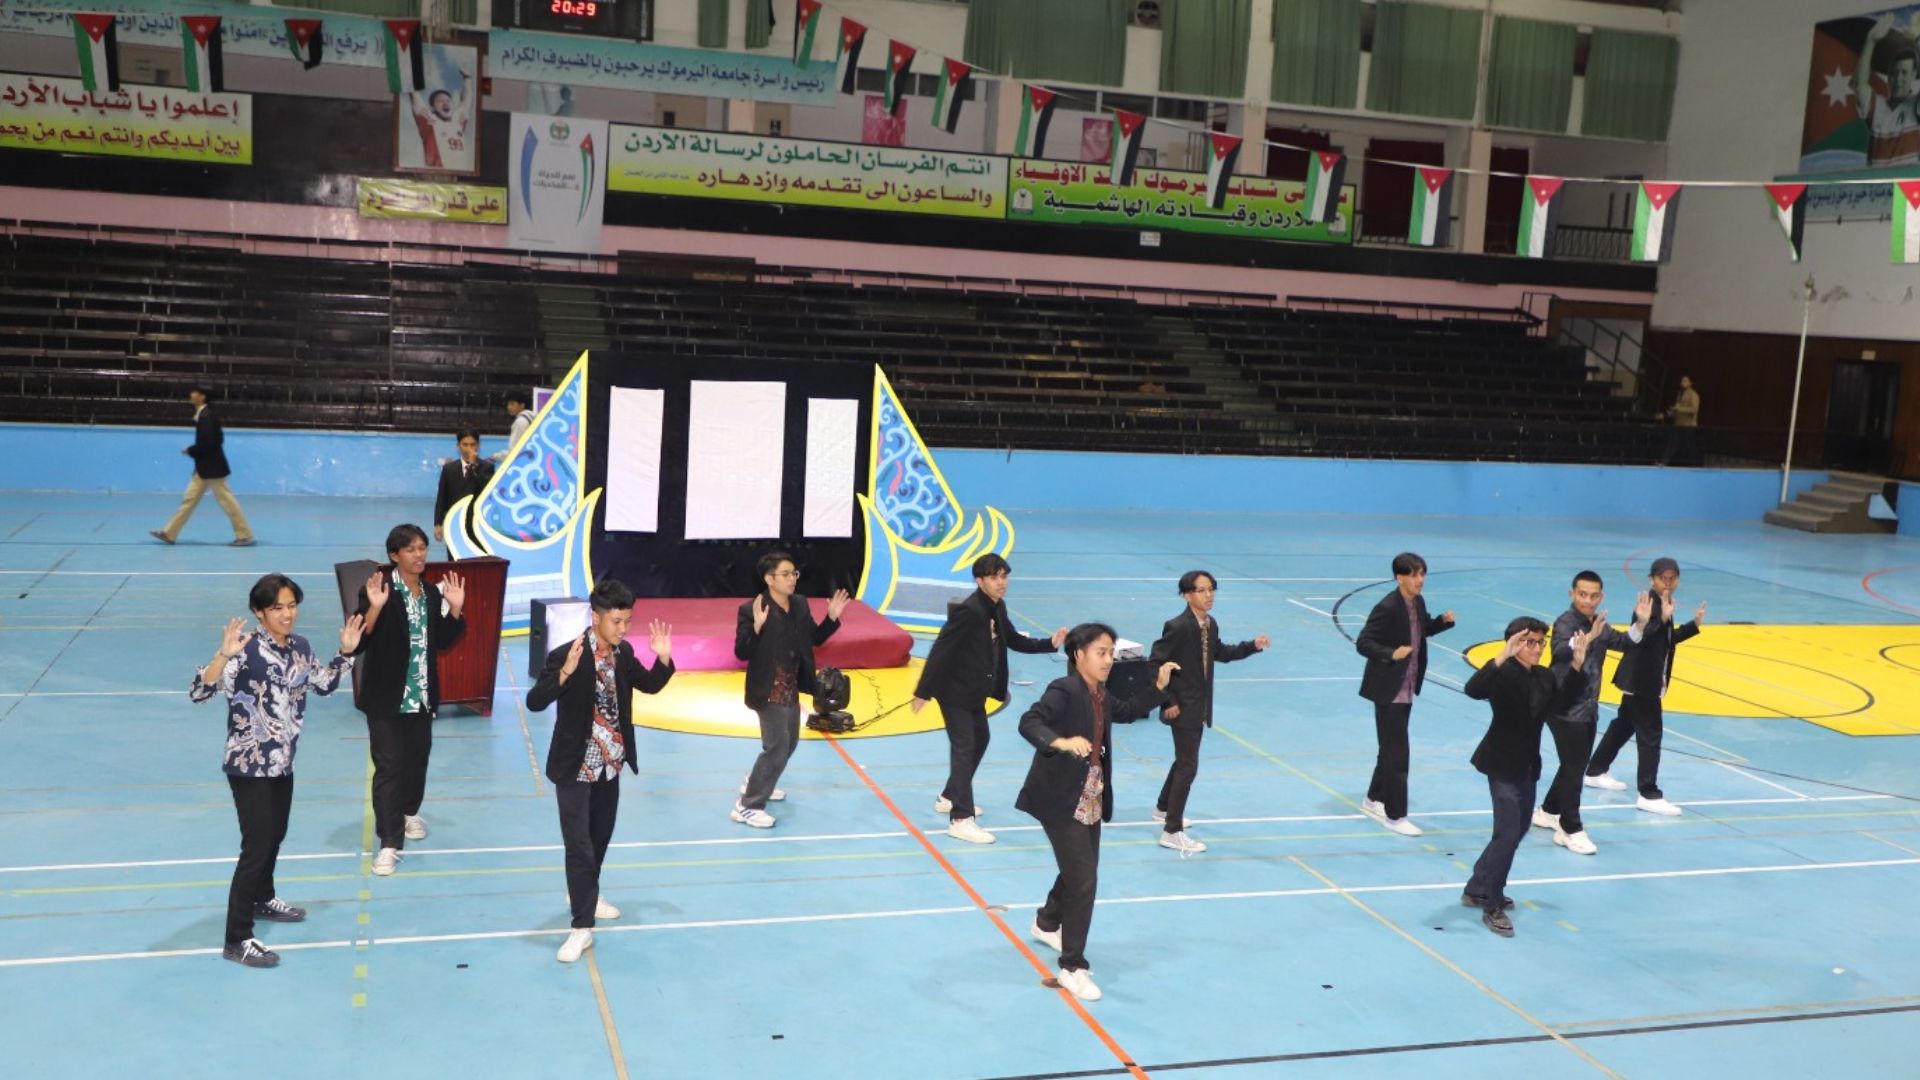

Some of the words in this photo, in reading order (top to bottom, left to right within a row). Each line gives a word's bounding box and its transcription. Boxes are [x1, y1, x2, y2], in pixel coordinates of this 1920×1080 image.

[502, 46, 540, 68] الكرام
[604, 54, 655, 78] يرحبون
[711, 64, 750, 86] جامعة
[62, 88, 131, 115] شباب
[32, 122, 55, 143] من
[60, 125, 95, 147] نعم
[690, 134, 764, 161] لرسالة
[767, 145, 859, 164] الحاملون
[861, 151, 943, 174] الفرسان
[471, 195, 499, 215] على
[897, 184, 992, 208] والساعون
[1043, 189, 1150, 218] الهاشمية
